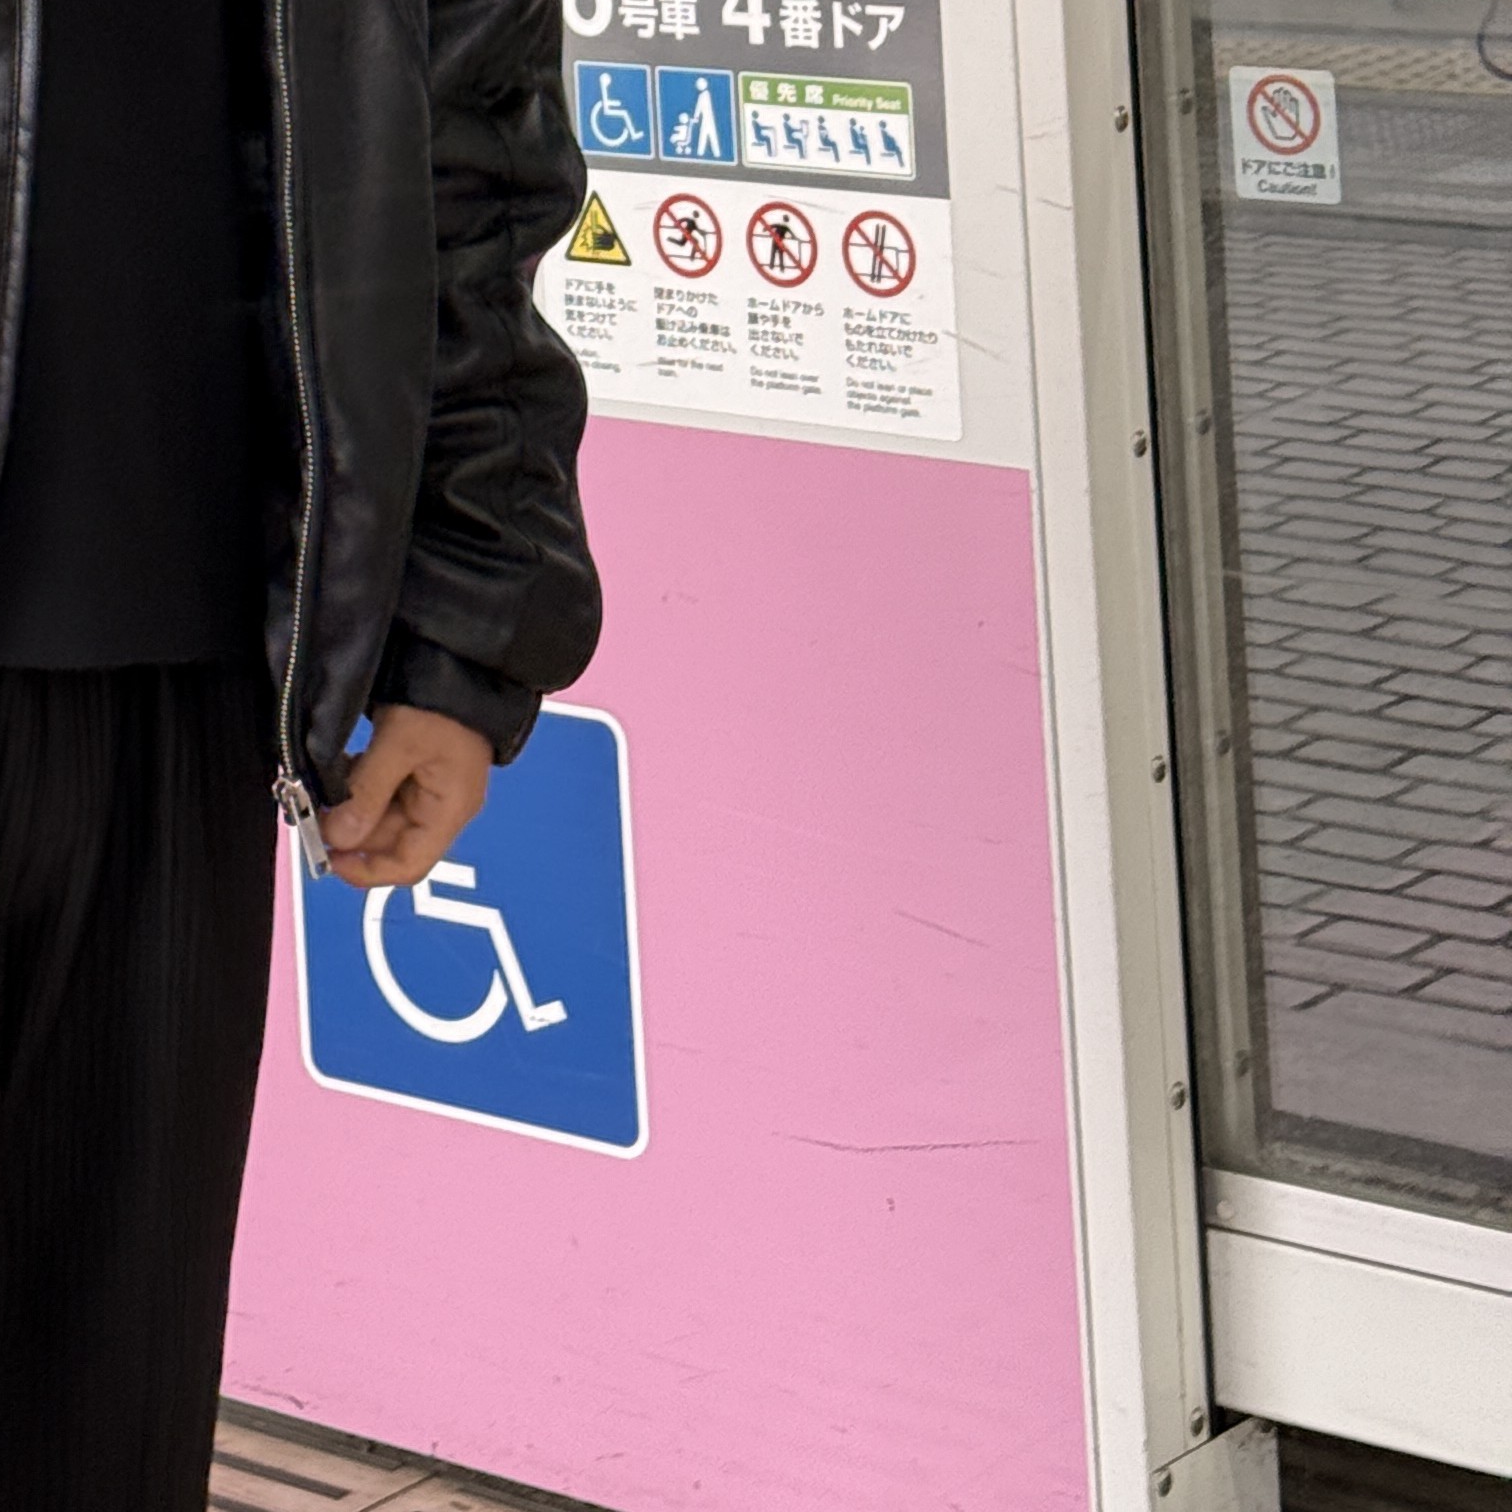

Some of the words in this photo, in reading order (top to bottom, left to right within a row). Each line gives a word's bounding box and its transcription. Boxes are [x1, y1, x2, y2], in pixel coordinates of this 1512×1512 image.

[747, 79, 825, 105] 優先席
[1240, 157, 1336, 180] ドアにご注意!
[564, 277, 616, 295] ドアに手を
[656, 302, 698, 318] ドアへの
[747, 296, 825, 317] ホームドアから
[843, 306, 912, 326] ホームドアに
[566, 325, 613, 341] ください。
[749, 344, 800, 362] ください。
[846, 354, 897, 372] ください。
